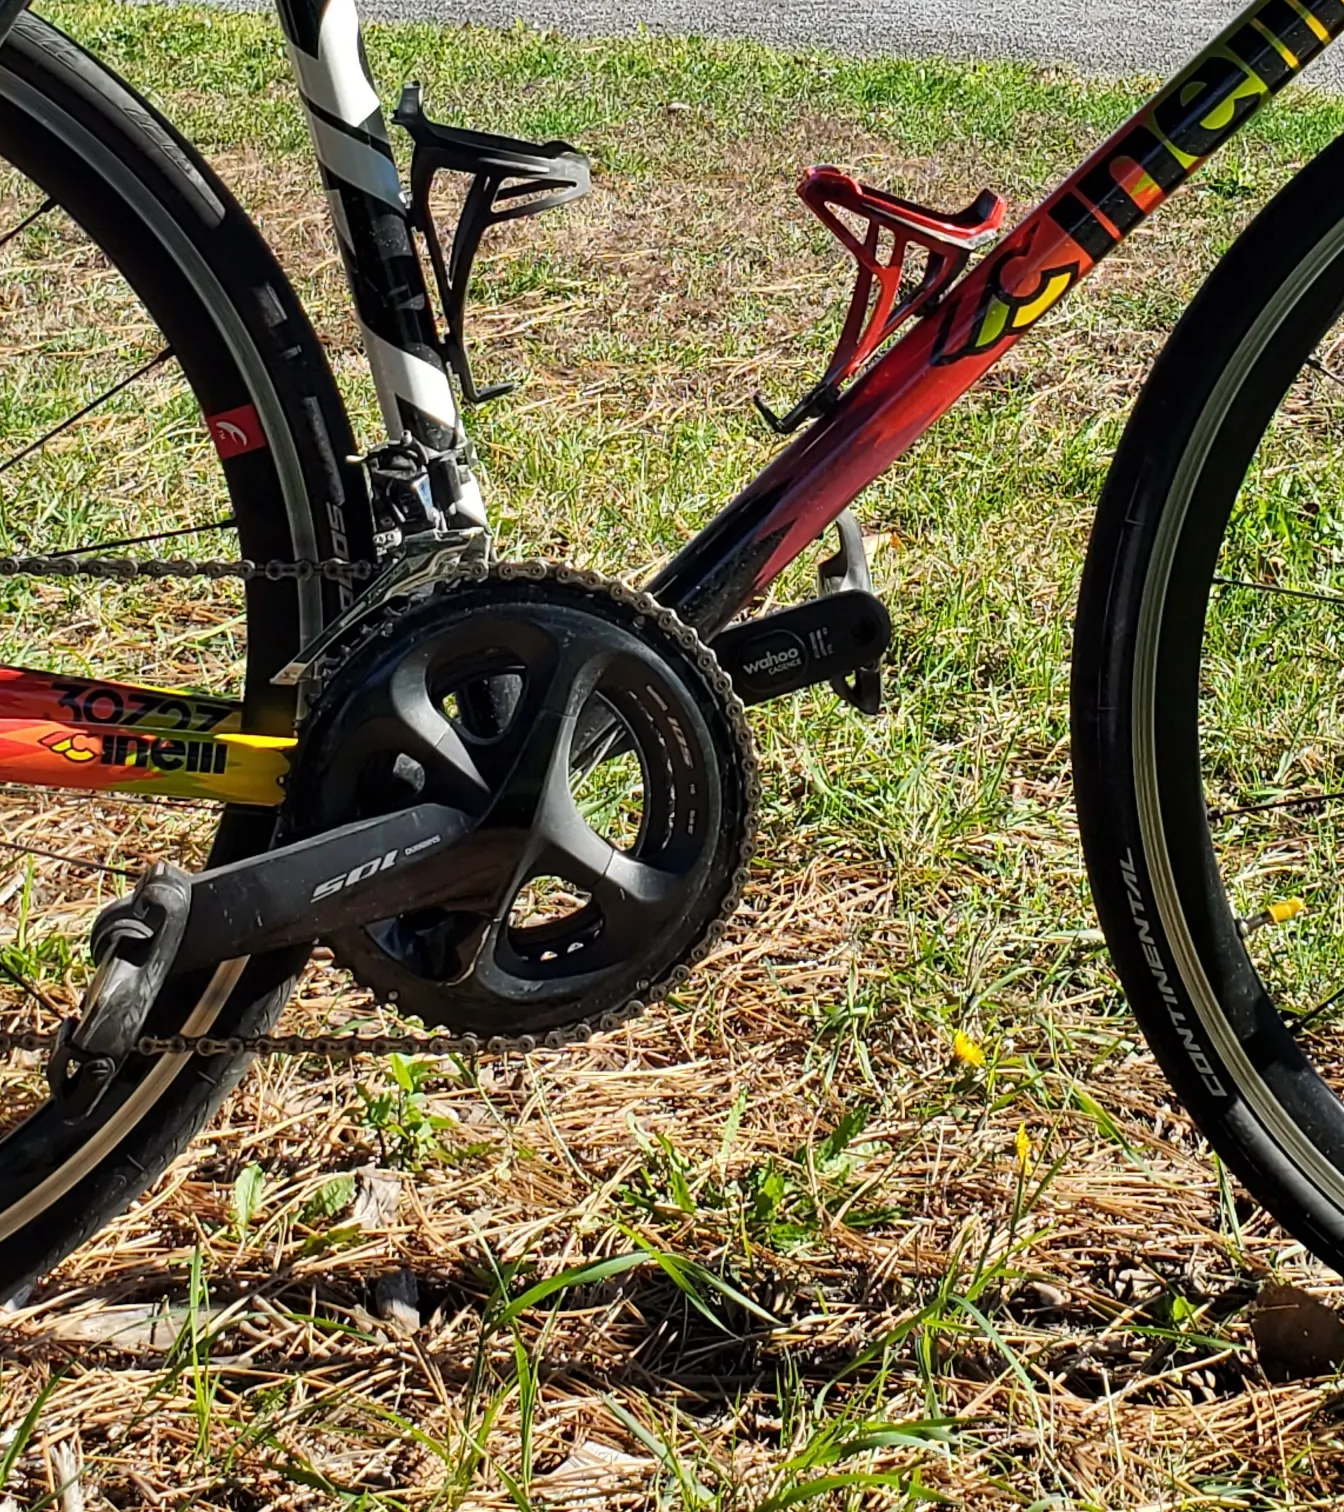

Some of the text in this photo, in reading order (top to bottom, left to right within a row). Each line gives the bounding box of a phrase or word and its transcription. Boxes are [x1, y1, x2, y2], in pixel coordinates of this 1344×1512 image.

[742, 648, 799, 675] wahoo
[310, 849, 399, 904] 105
[1119, 846, 1227, 1097] CONTINENTAL
